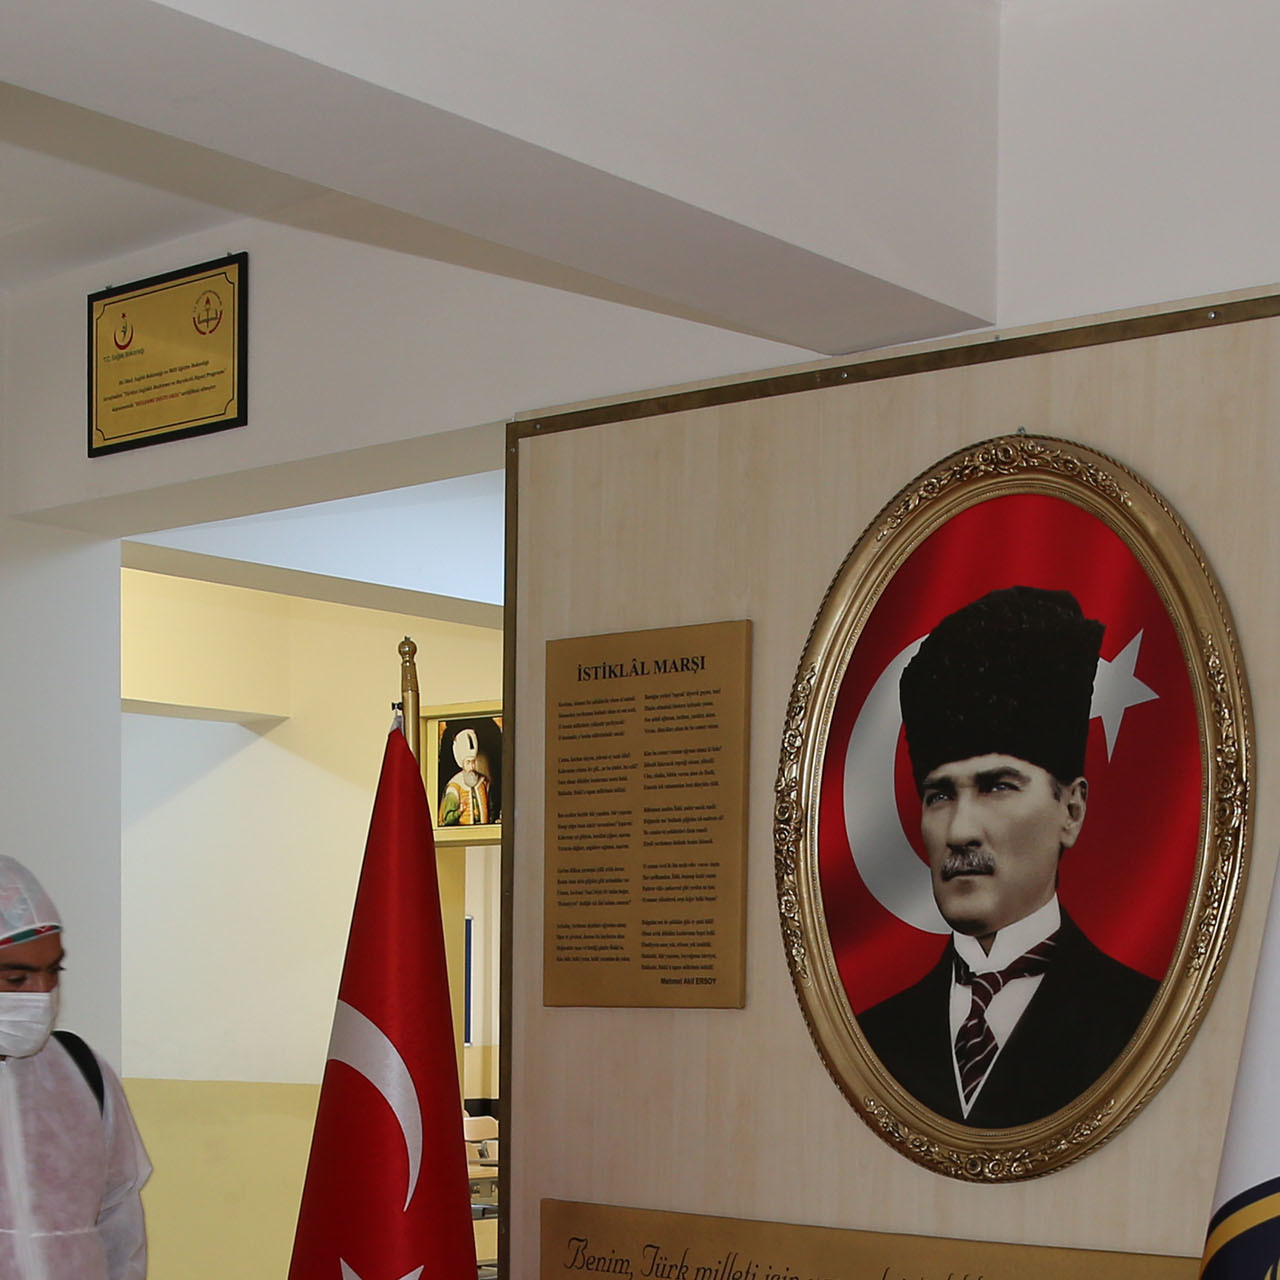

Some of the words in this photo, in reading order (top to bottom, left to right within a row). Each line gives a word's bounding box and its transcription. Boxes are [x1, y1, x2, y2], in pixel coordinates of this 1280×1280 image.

[577, 658, 649, 681] İSTİKLÂL
[654, 656, 705, 674] MARŞI
[640, 1244, 688, 1280] Türk
